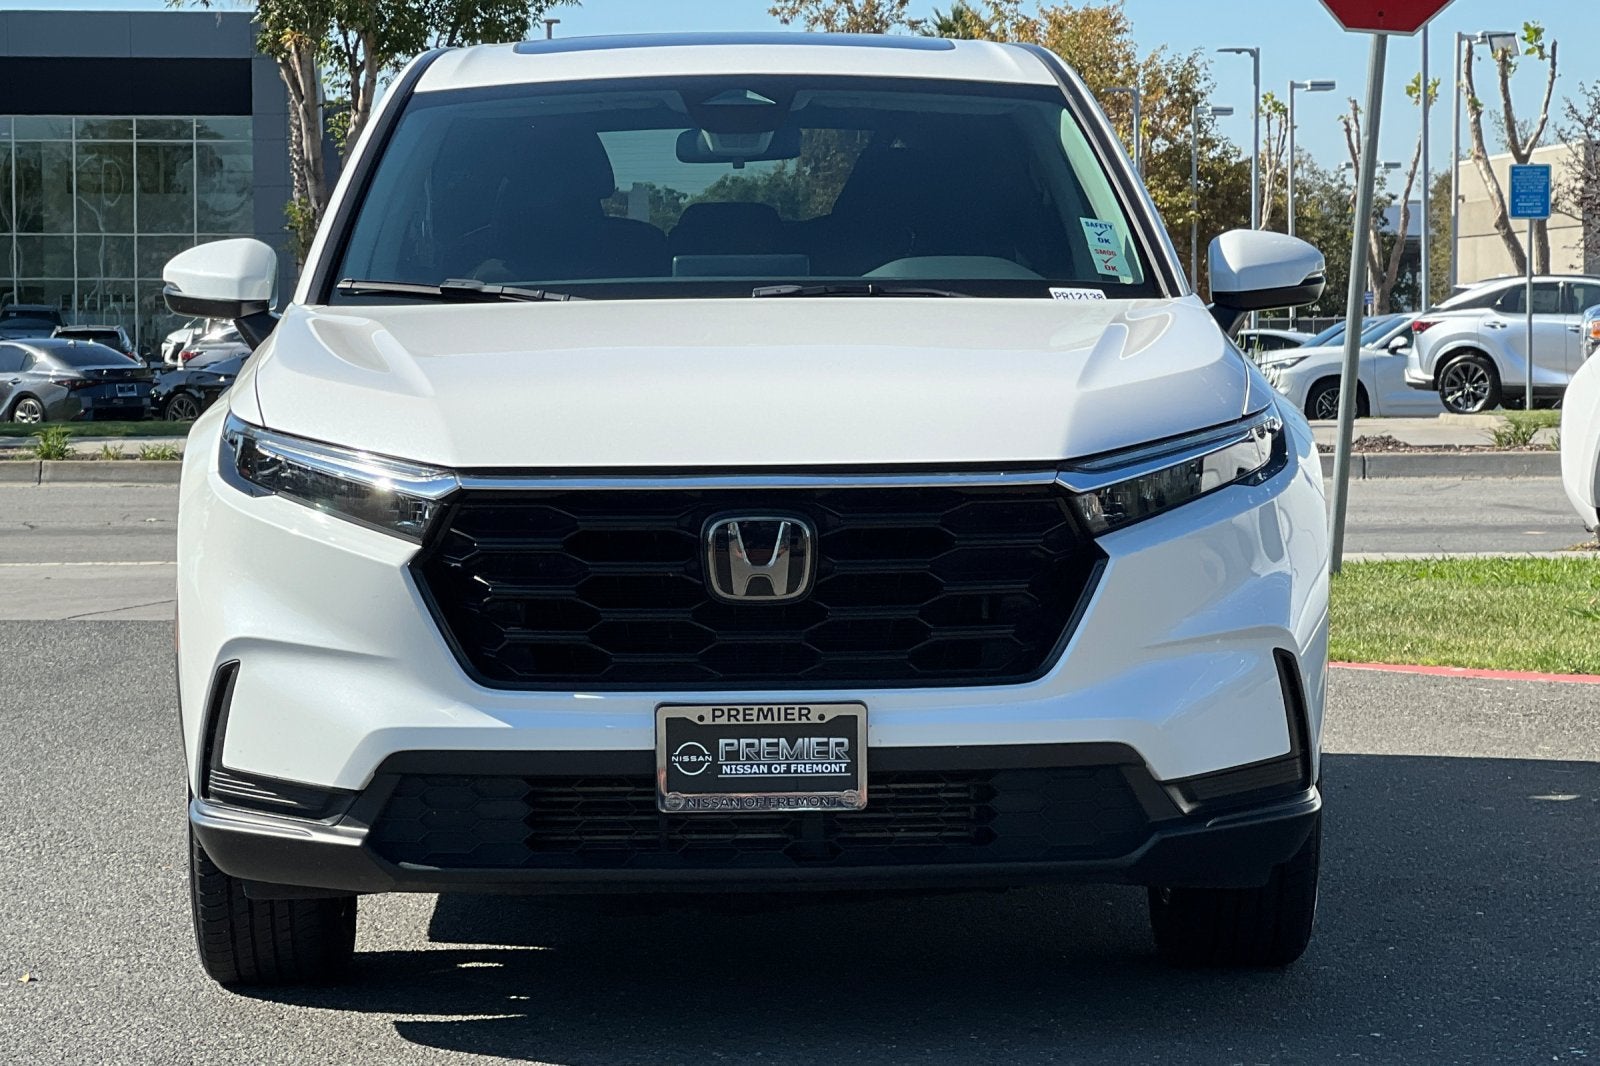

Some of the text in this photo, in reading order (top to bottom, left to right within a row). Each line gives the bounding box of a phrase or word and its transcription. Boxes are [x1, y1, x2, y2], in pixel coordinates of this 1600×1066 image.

[1084, 221, 1113, 230] SAFETY
[1104, 264, 1118, 272] OK
[711, 707, 812, 723] PREMIER
[718, 737, 850, 761] PREMIER
[722, 763, 847, 774] NISSAN OF FREMONT
[687, 795, 839, 808] NISSAN OF FREMONT
